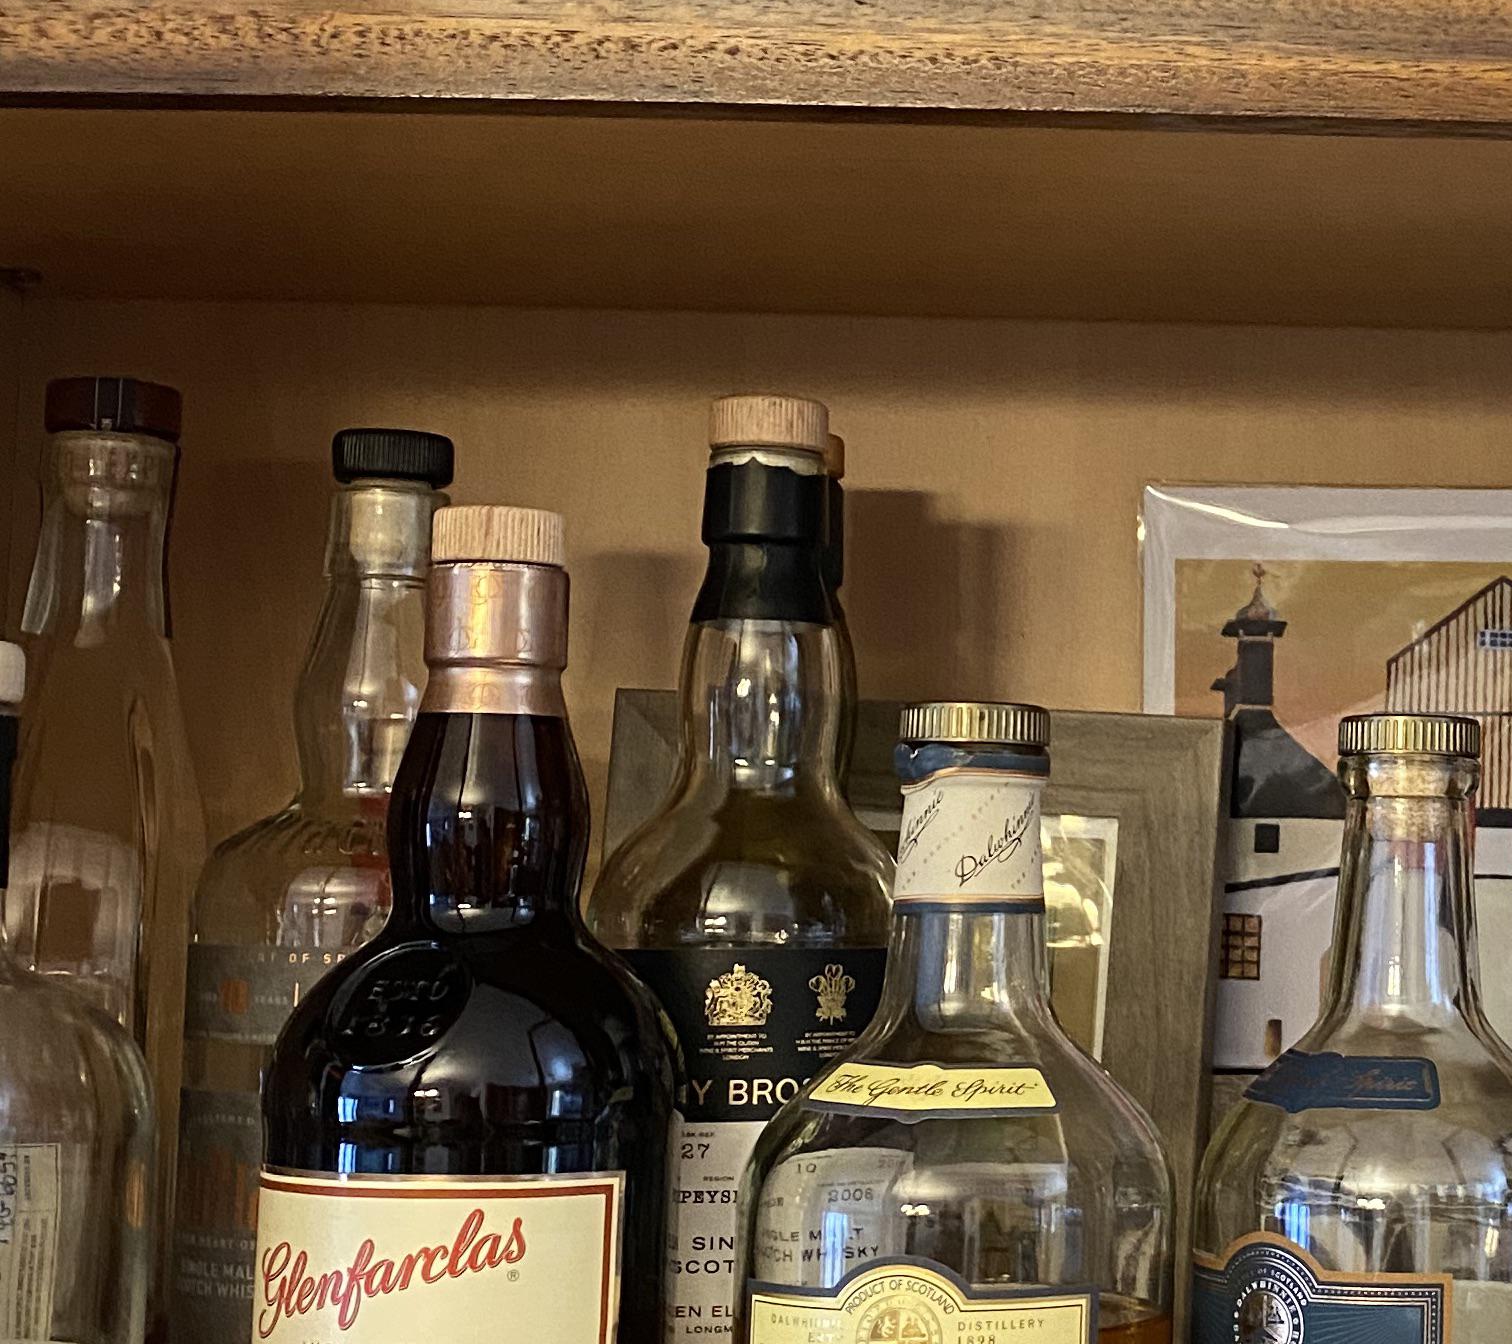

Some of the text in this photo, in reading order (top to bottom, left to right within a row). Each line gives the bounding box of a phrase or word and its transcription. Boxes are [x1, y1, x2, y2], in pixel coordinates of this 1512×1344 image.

[826, 1072, 1031, 1107] The Gentle Spirit
[259, 1208, 527, 1339] Glenfarclas
[958, 1319, 1045, 1331] DISTILLERY
